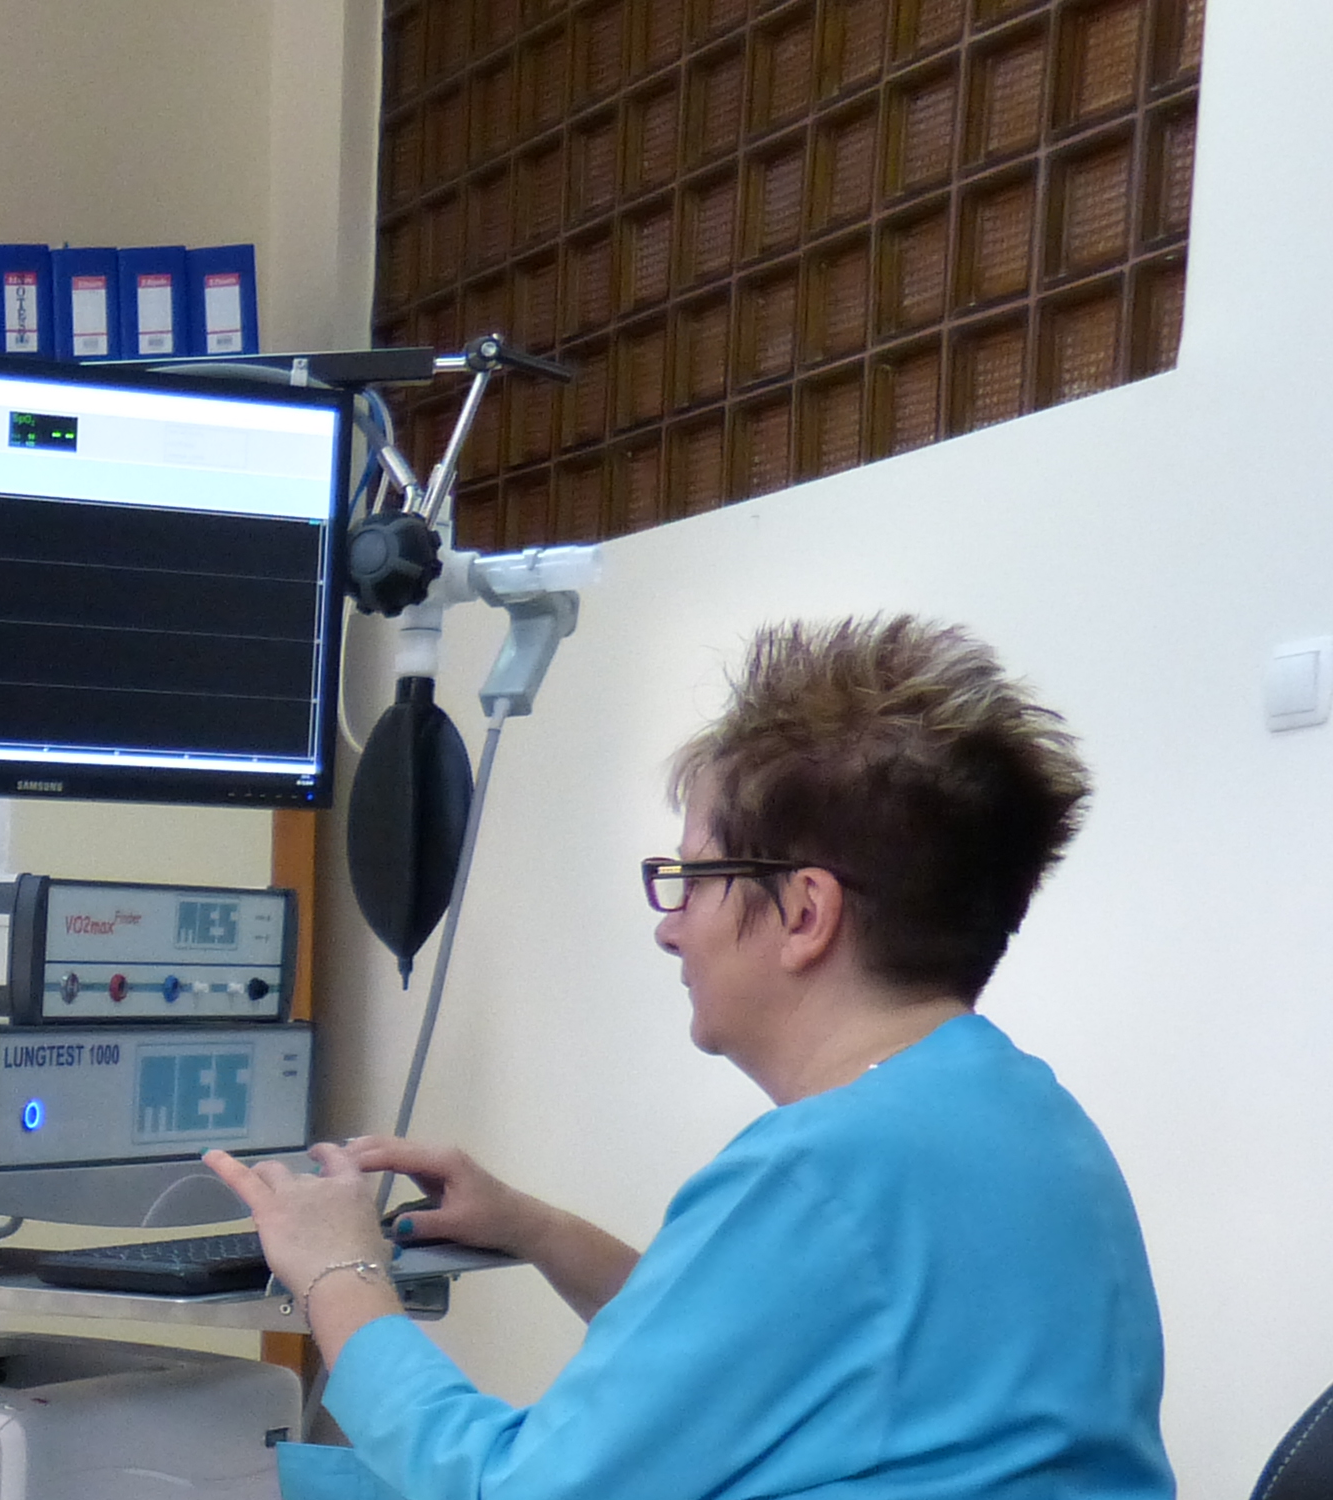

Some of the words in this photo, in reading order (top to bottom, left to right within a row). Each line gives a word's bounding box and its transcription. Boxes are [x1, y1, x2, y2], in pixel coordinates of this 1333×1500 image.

[16, 780, 64, 792] SAMSUNG
[65, 915, 116, 935] VO2max
[4, 1043, 84, 1069] LUNGTEST
[89, 1044, 120, 1066] 1000
